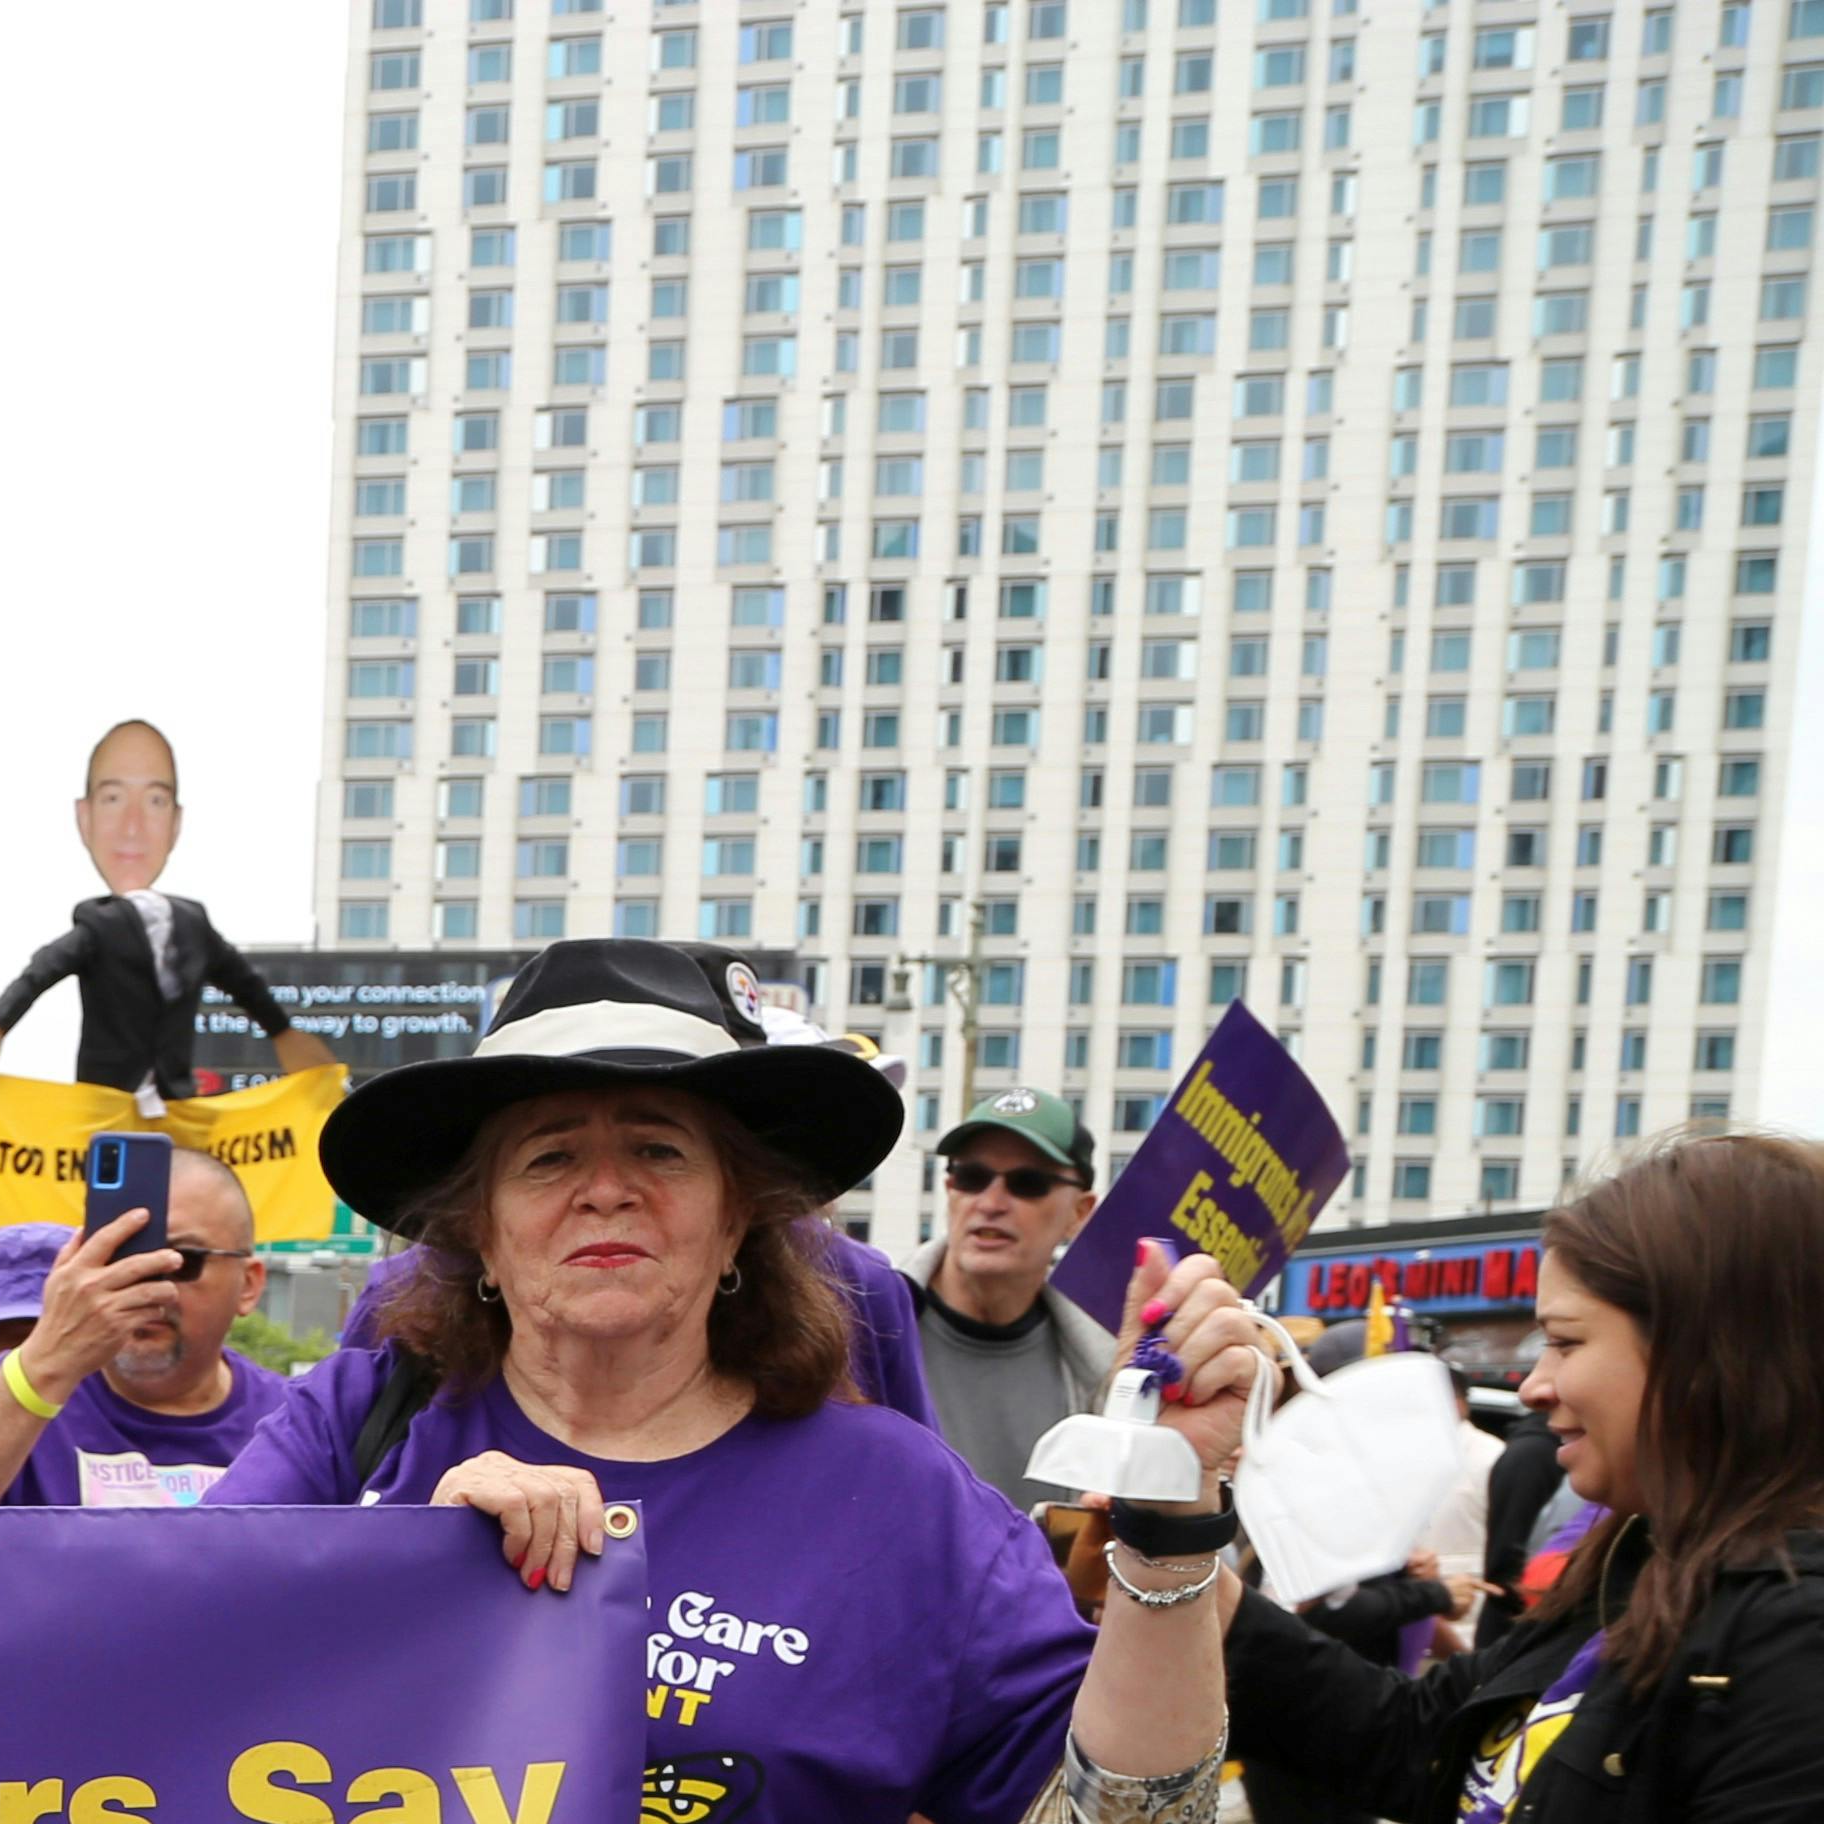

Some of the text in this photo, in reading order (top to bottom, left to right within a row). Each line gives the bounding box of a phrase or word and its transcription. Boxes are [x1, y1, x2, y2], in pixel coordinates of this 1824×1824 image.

[301, 985, 354, 1008] your
[356, 981, 487, 1004] connection
[209, 1012, 250, 1033] the
[352, 1013, 379, 1033] to
[381, 1012, 473, 1038] growth.
[1174, 1060, 1301, 1227] Immigrants
[1307, 1256, 1399, 1311] LEO'S
[1406, 1258, 1478, 1298] MINI
[1482, 1248, 1538, 1298] MA
[668, 1591, 809, 1665] Care
[647, 1633, 736, 1692] for
[647, 1684, 712, 1726] NT
